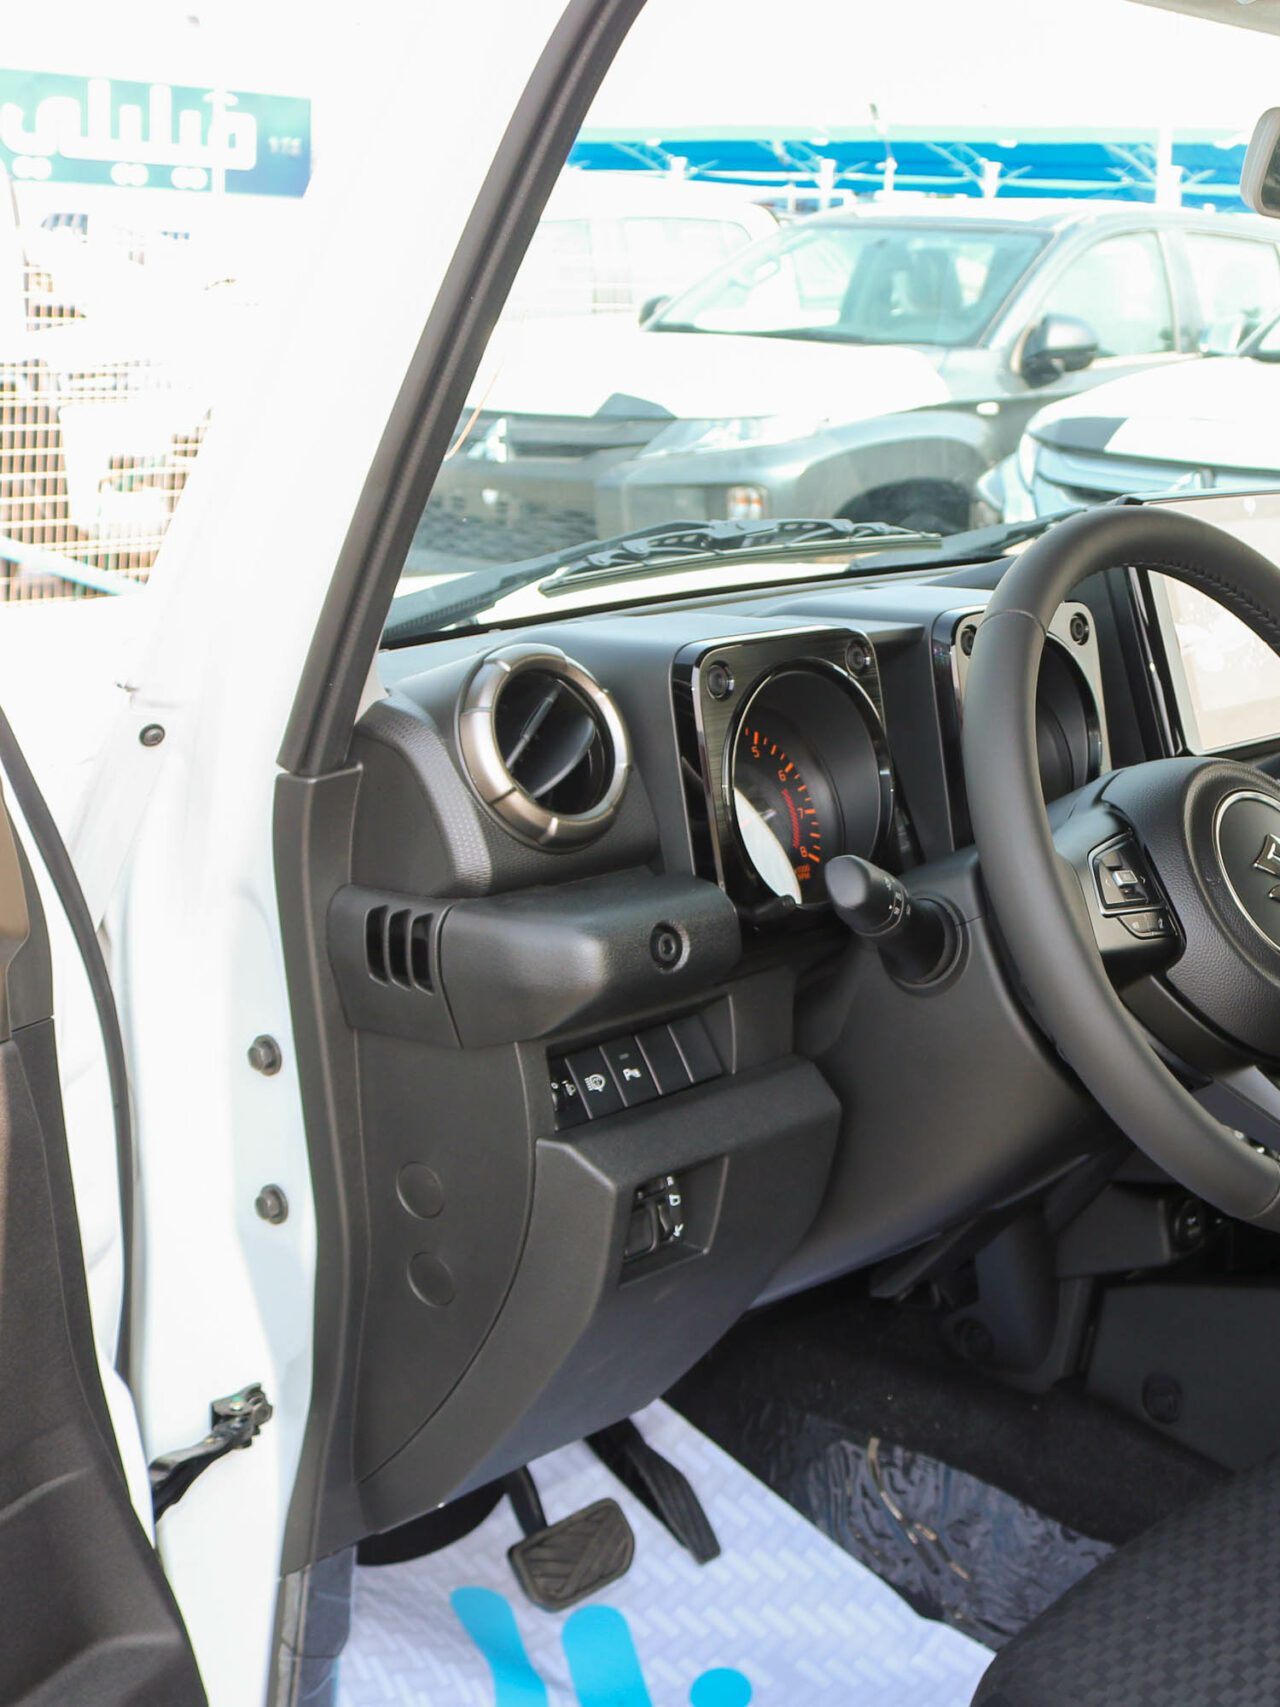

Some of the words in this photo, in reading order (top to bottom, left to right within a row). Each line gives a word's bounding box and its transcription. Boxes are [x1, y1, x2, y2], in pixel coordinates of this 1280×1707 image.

[751, 747, 761, 759] 5
[777, 769, 787, 782] 6
[796, 808, 806, 820] 7
[799, 846, 809, 858] 8
